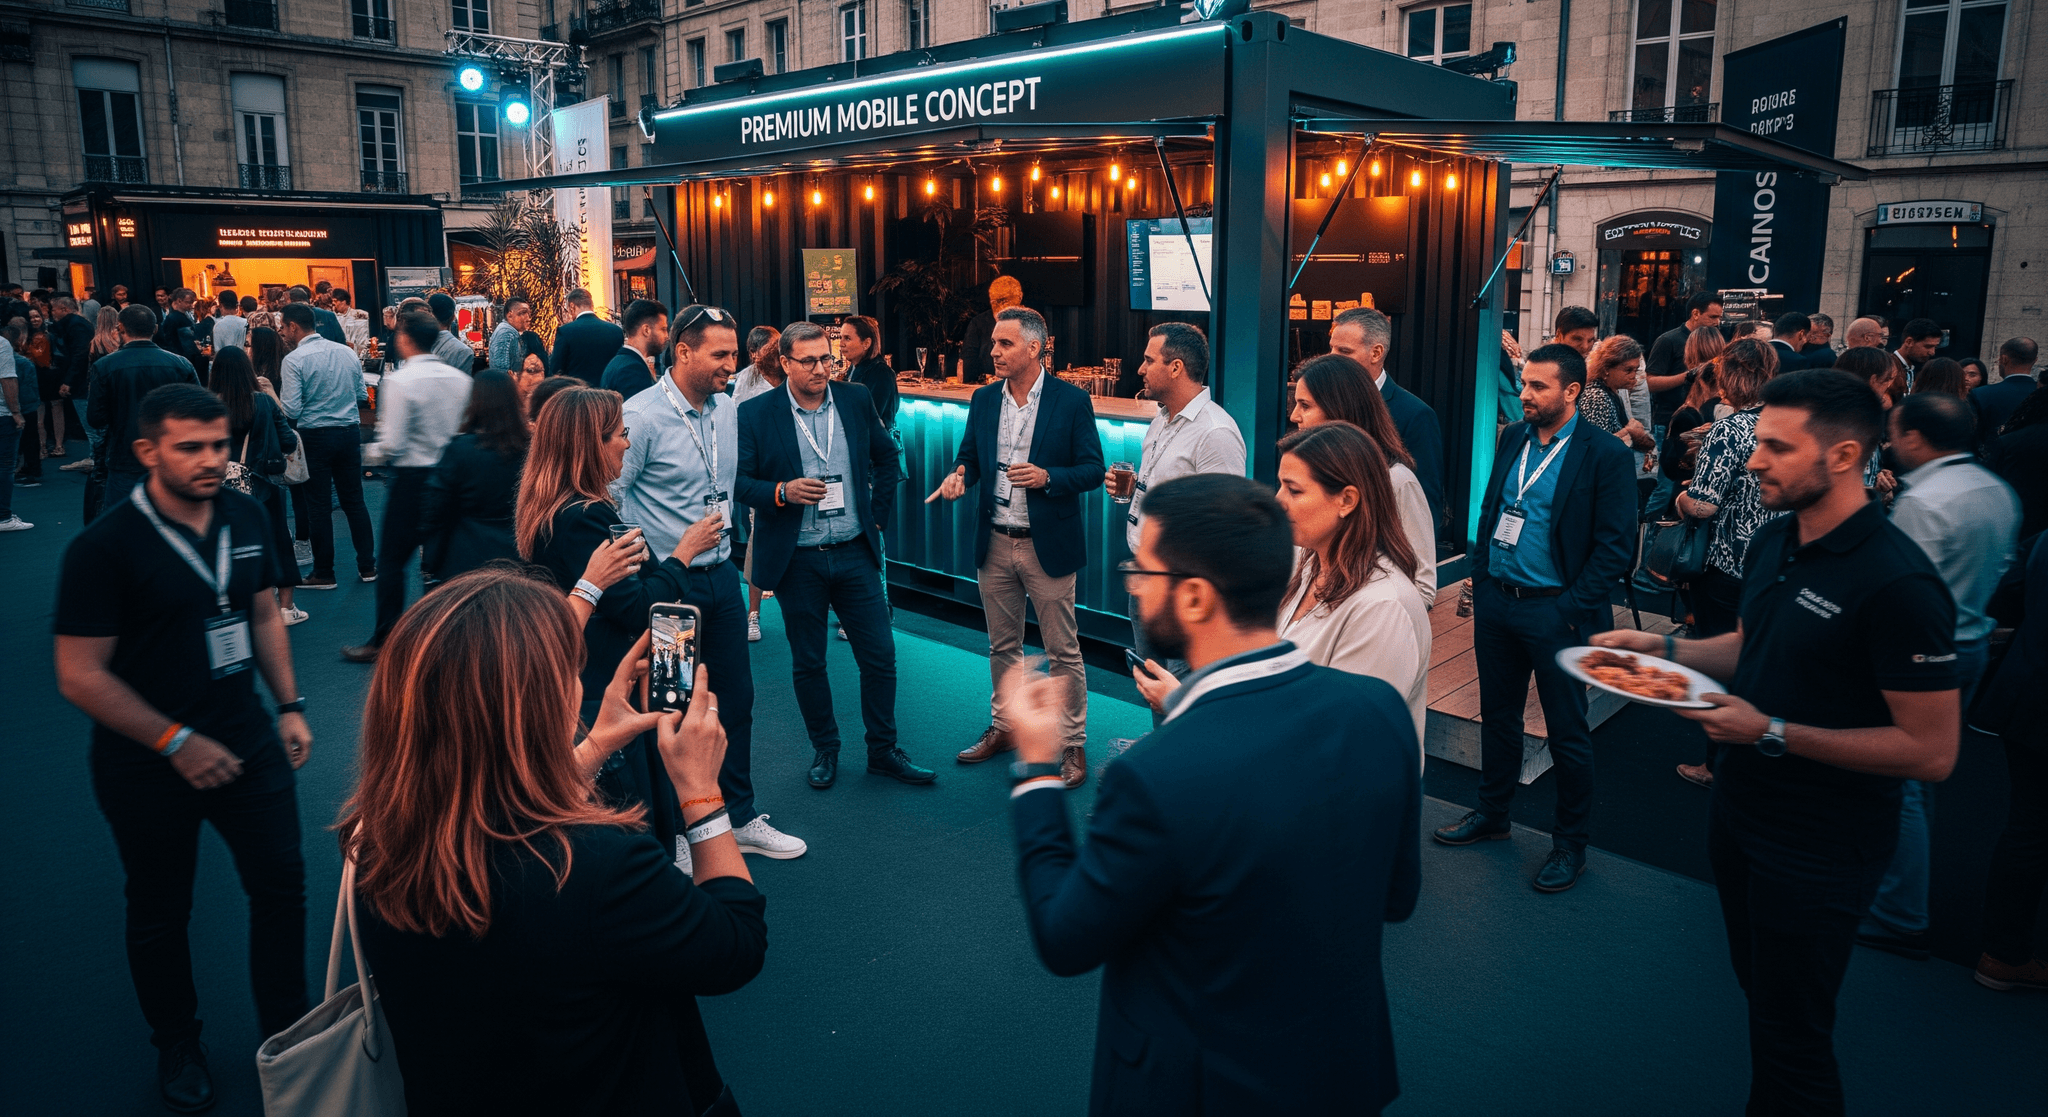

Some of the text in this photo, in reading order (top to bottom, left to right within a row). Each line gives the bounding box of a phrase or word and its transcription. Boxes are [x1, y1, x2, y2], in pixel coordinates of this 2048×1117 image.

[741, 76, 1041, 144] PREMIUM MOBILE CONCEPT
